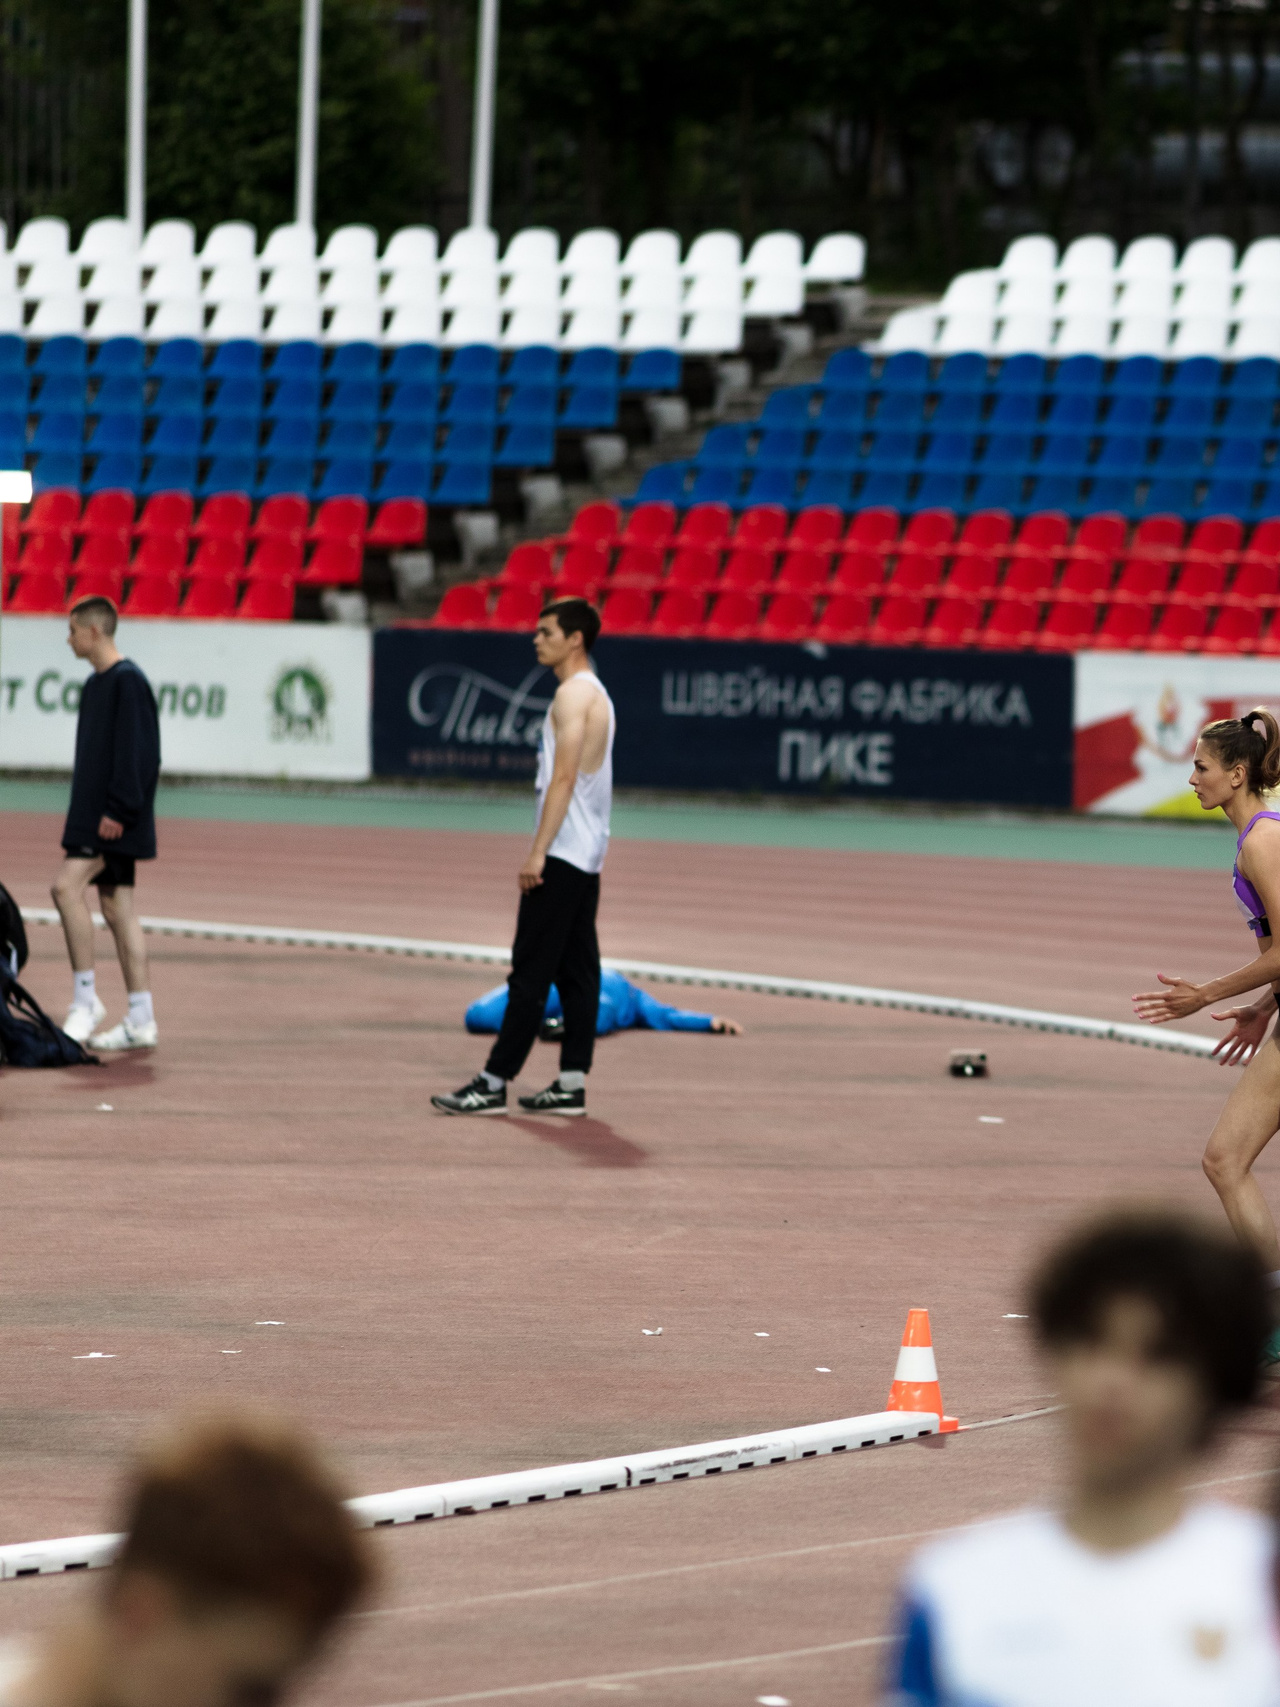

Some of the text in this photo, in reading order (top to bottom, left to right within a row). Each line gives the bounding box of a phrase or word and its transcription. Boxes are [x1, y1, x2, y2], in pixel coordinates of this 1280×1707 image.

[661, 665, 1033, 728] ШВЕЙНАЯ ФАБРИКА
[778, 729, 895, 785] ПИКЕ
